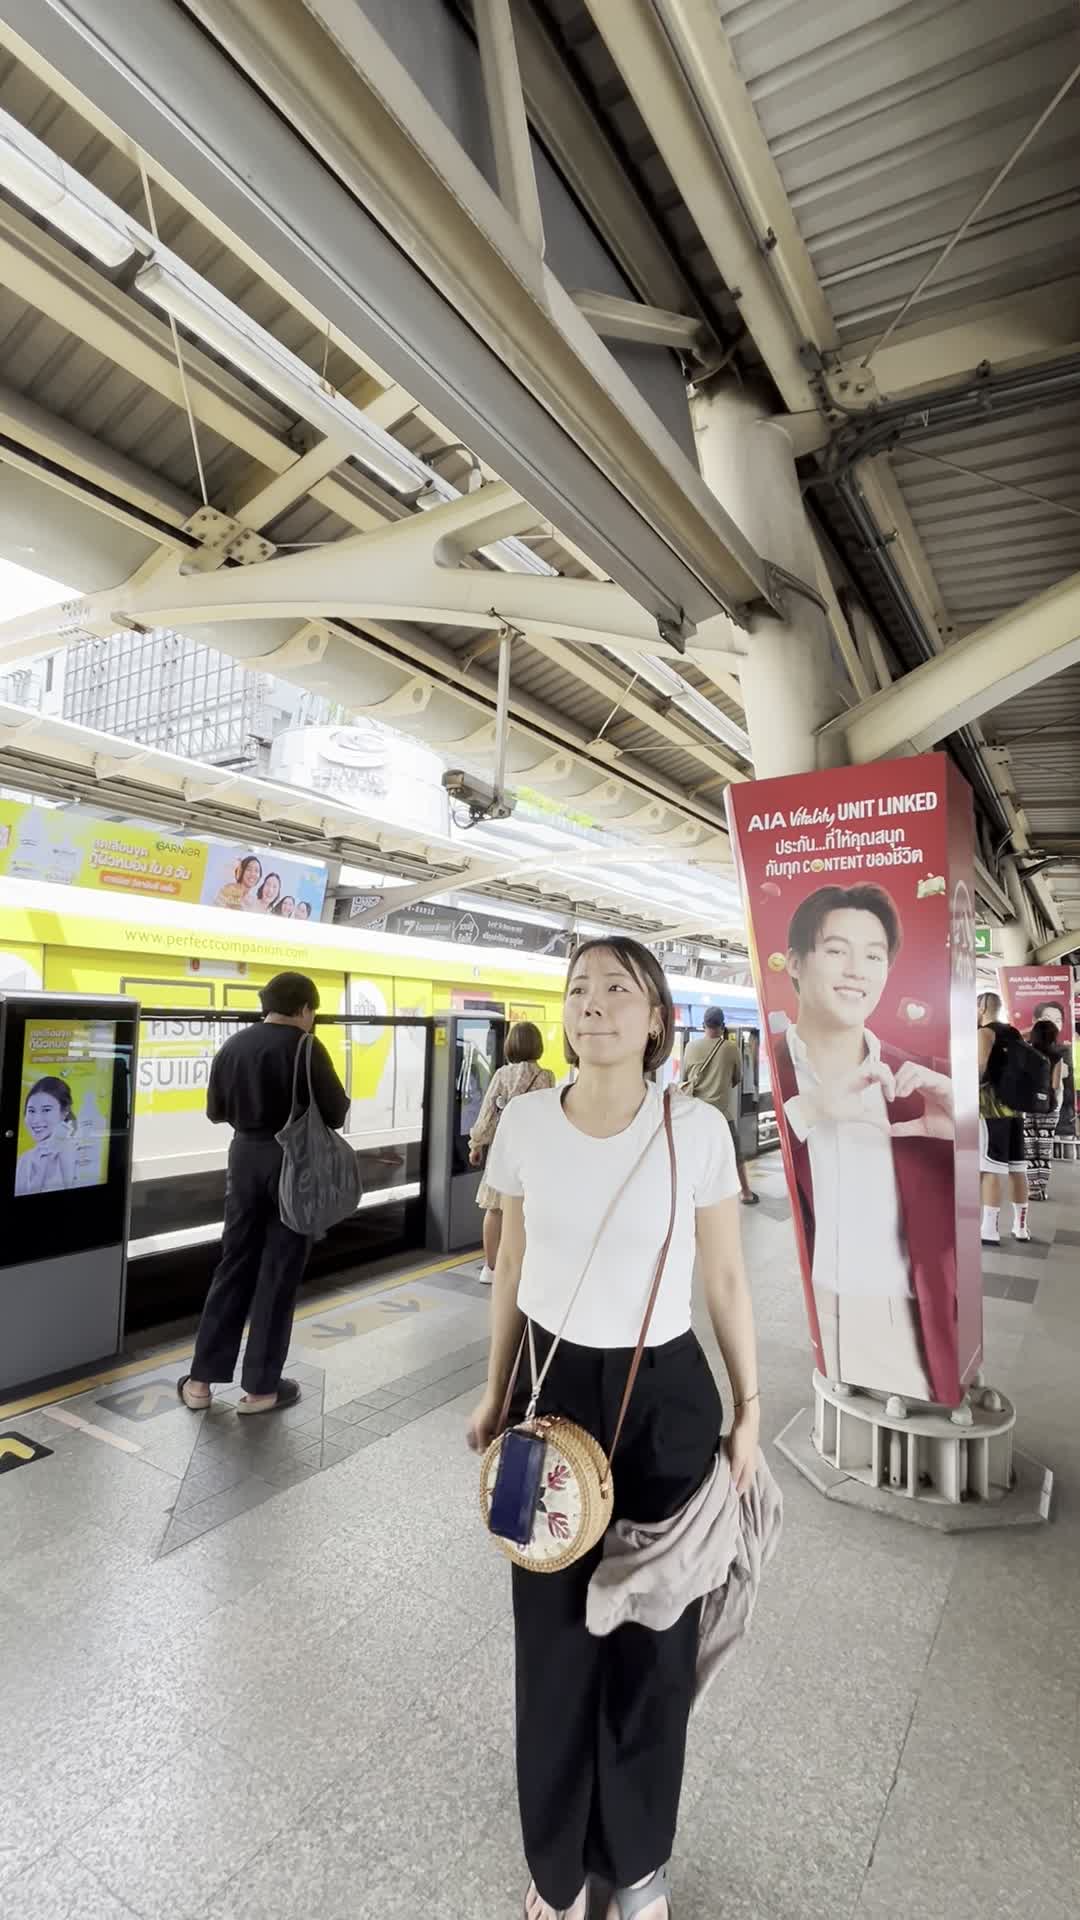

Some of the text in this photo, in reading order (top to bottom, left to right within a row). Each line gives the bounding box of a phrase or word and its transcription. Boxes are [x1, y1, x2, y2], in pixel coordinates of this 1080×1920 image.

[747, 791, 938, 832] AIA Vitality UNIT LINKED
[155, 840, 201, 858] GARNIER
[766, 859, 801, 880] กับทุก
[866, 847, 923, 869] ของชีวิต
[163, 865, 174, 876] 3
[124, 929, 309, 961] www.perfectcompanion.com
